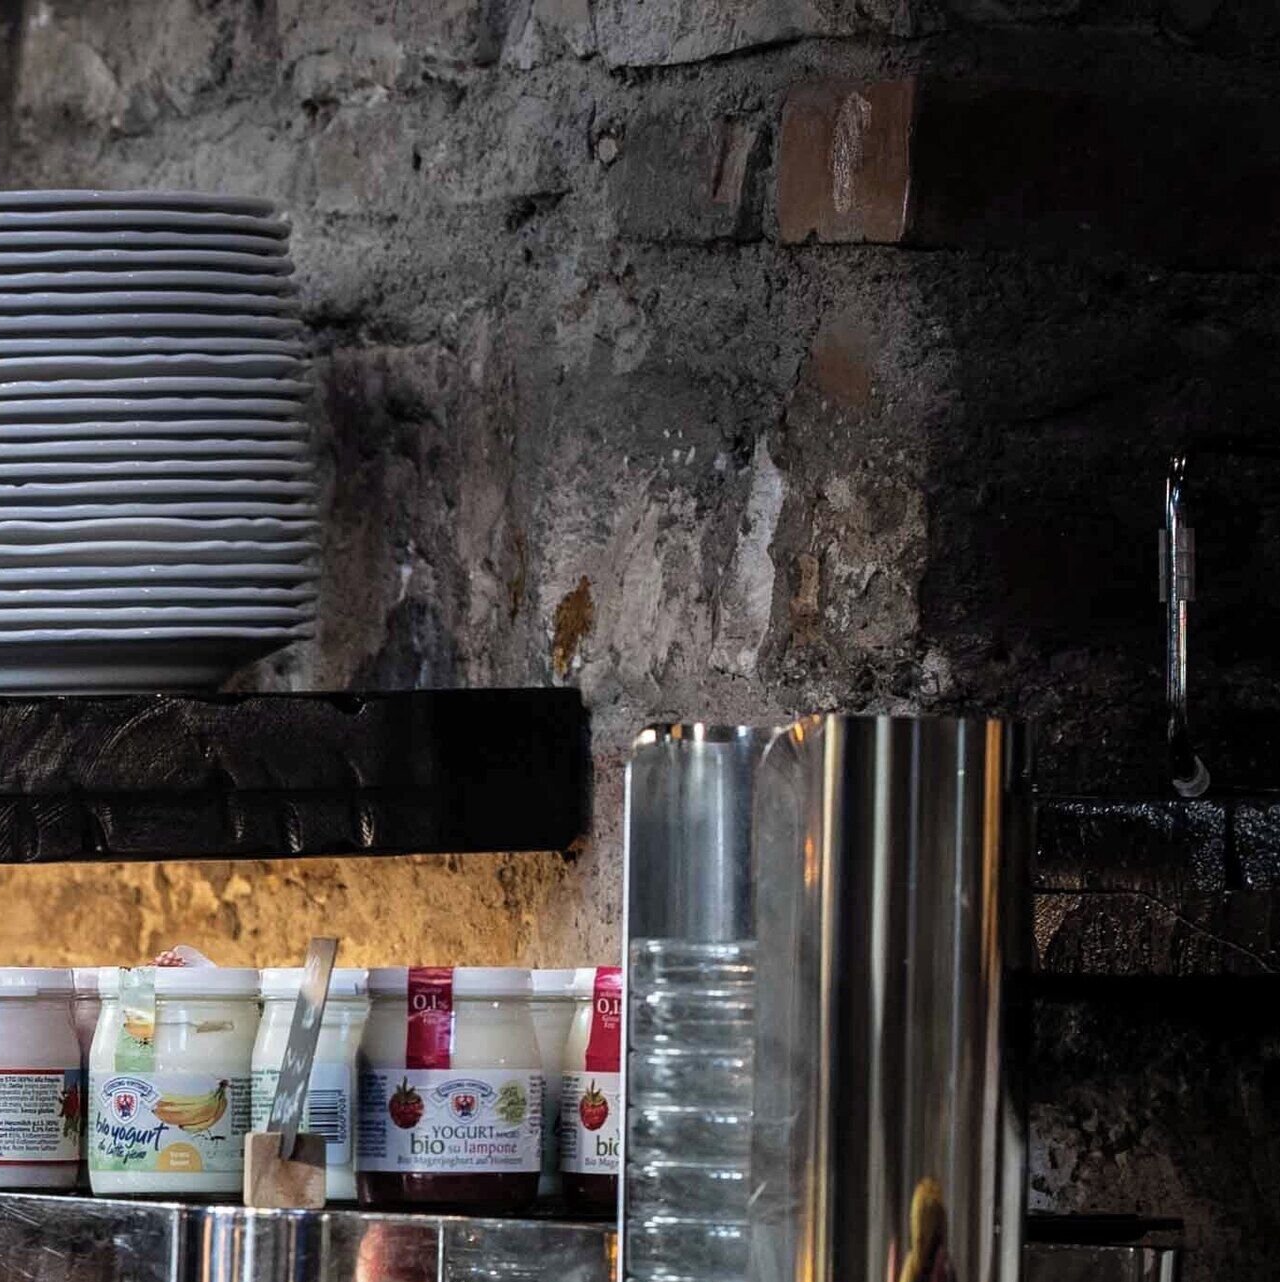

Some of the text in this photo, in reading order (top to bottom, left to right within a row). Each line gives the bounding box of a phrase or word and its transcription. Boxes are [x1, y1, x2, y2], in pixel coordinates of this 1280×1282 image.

[96, 1111, 169, 1151] bio yogurt
[432, 1126, 494, 1139] YOGURT
[410, 1133, 518, 1158] bio su lampone
